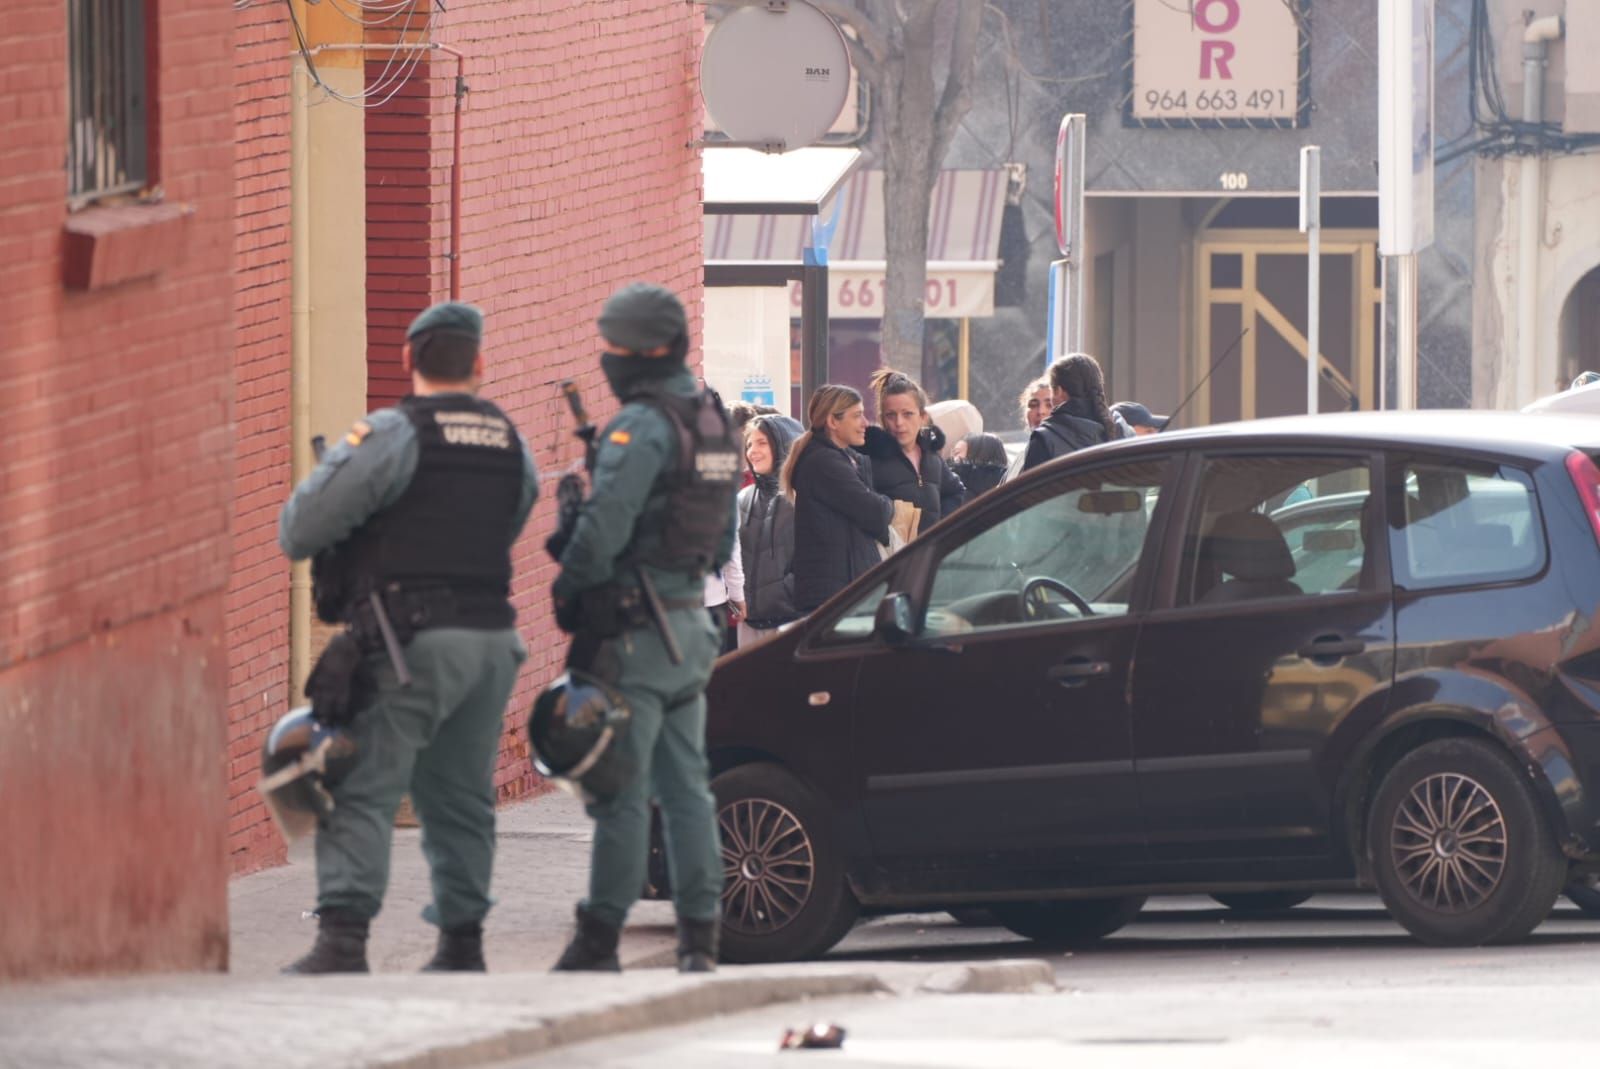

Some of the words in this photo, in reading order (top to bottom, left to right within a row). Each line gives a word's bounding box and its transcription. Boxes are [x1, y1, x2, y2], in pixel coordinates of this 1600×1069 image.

[1145, 89, 1188, 111] 964
[1196, 89, 1238, 111] 663
[1245, 89, 1285, 111] 491
[1220, 172, 1248, 190] 100
[925, 278, 957, 308] 01
